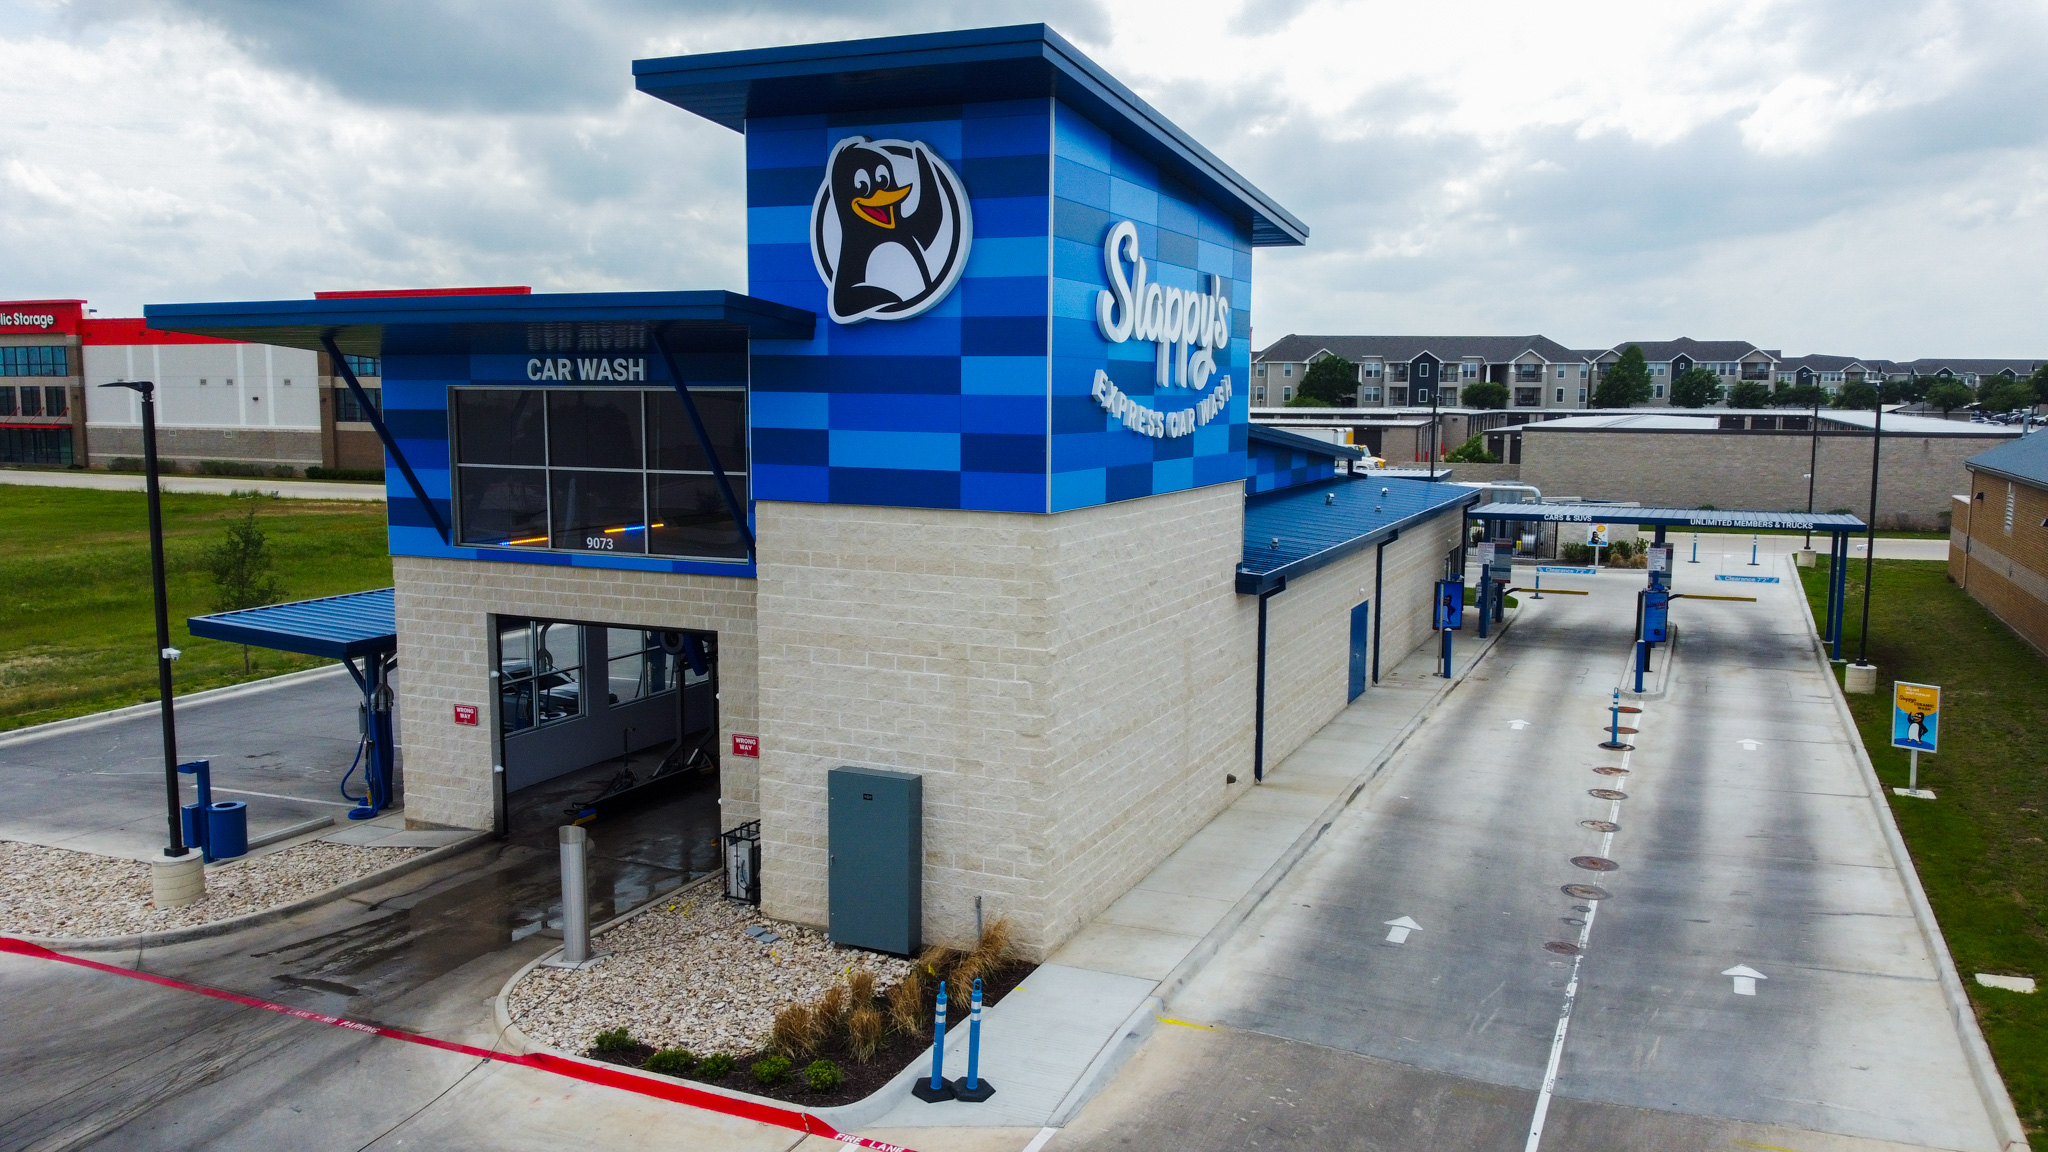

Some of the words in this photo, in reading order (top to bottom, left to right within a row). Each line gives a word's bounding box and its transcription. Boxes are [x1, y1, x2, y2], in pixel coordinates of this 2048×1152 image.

[1096, 220, 1229, 390] Slappy's
[13, 312, 54, 328] Storage
[526, 358, 571, 381] CAR
[577, 358, 644, 381] WASH
[1091, 369, 1164, 438] EXPRESS
[1166, 408, 1195, 438] CAR
[1196, 374, 1232, 426] WASH
[1690, 518, 1732, 527] UNLIMITED
[1734, 520, 1773, 528] MEMBERS
[1781, 521, 1814, 529] TRUCKS
[586, 537, 614, 550] 9073
[456, 706, 474, 714] WRONG
[735, 737, 756, 745] WRONG
[263, 1003, 283, 1012] FIRE
[286, 1009, 314, 1018] LANE
[321, 1016, 338, 1024] NO
[339, 1020, 381, 1034] PARKING
[834, 1132, 864, 1146] FIRE
